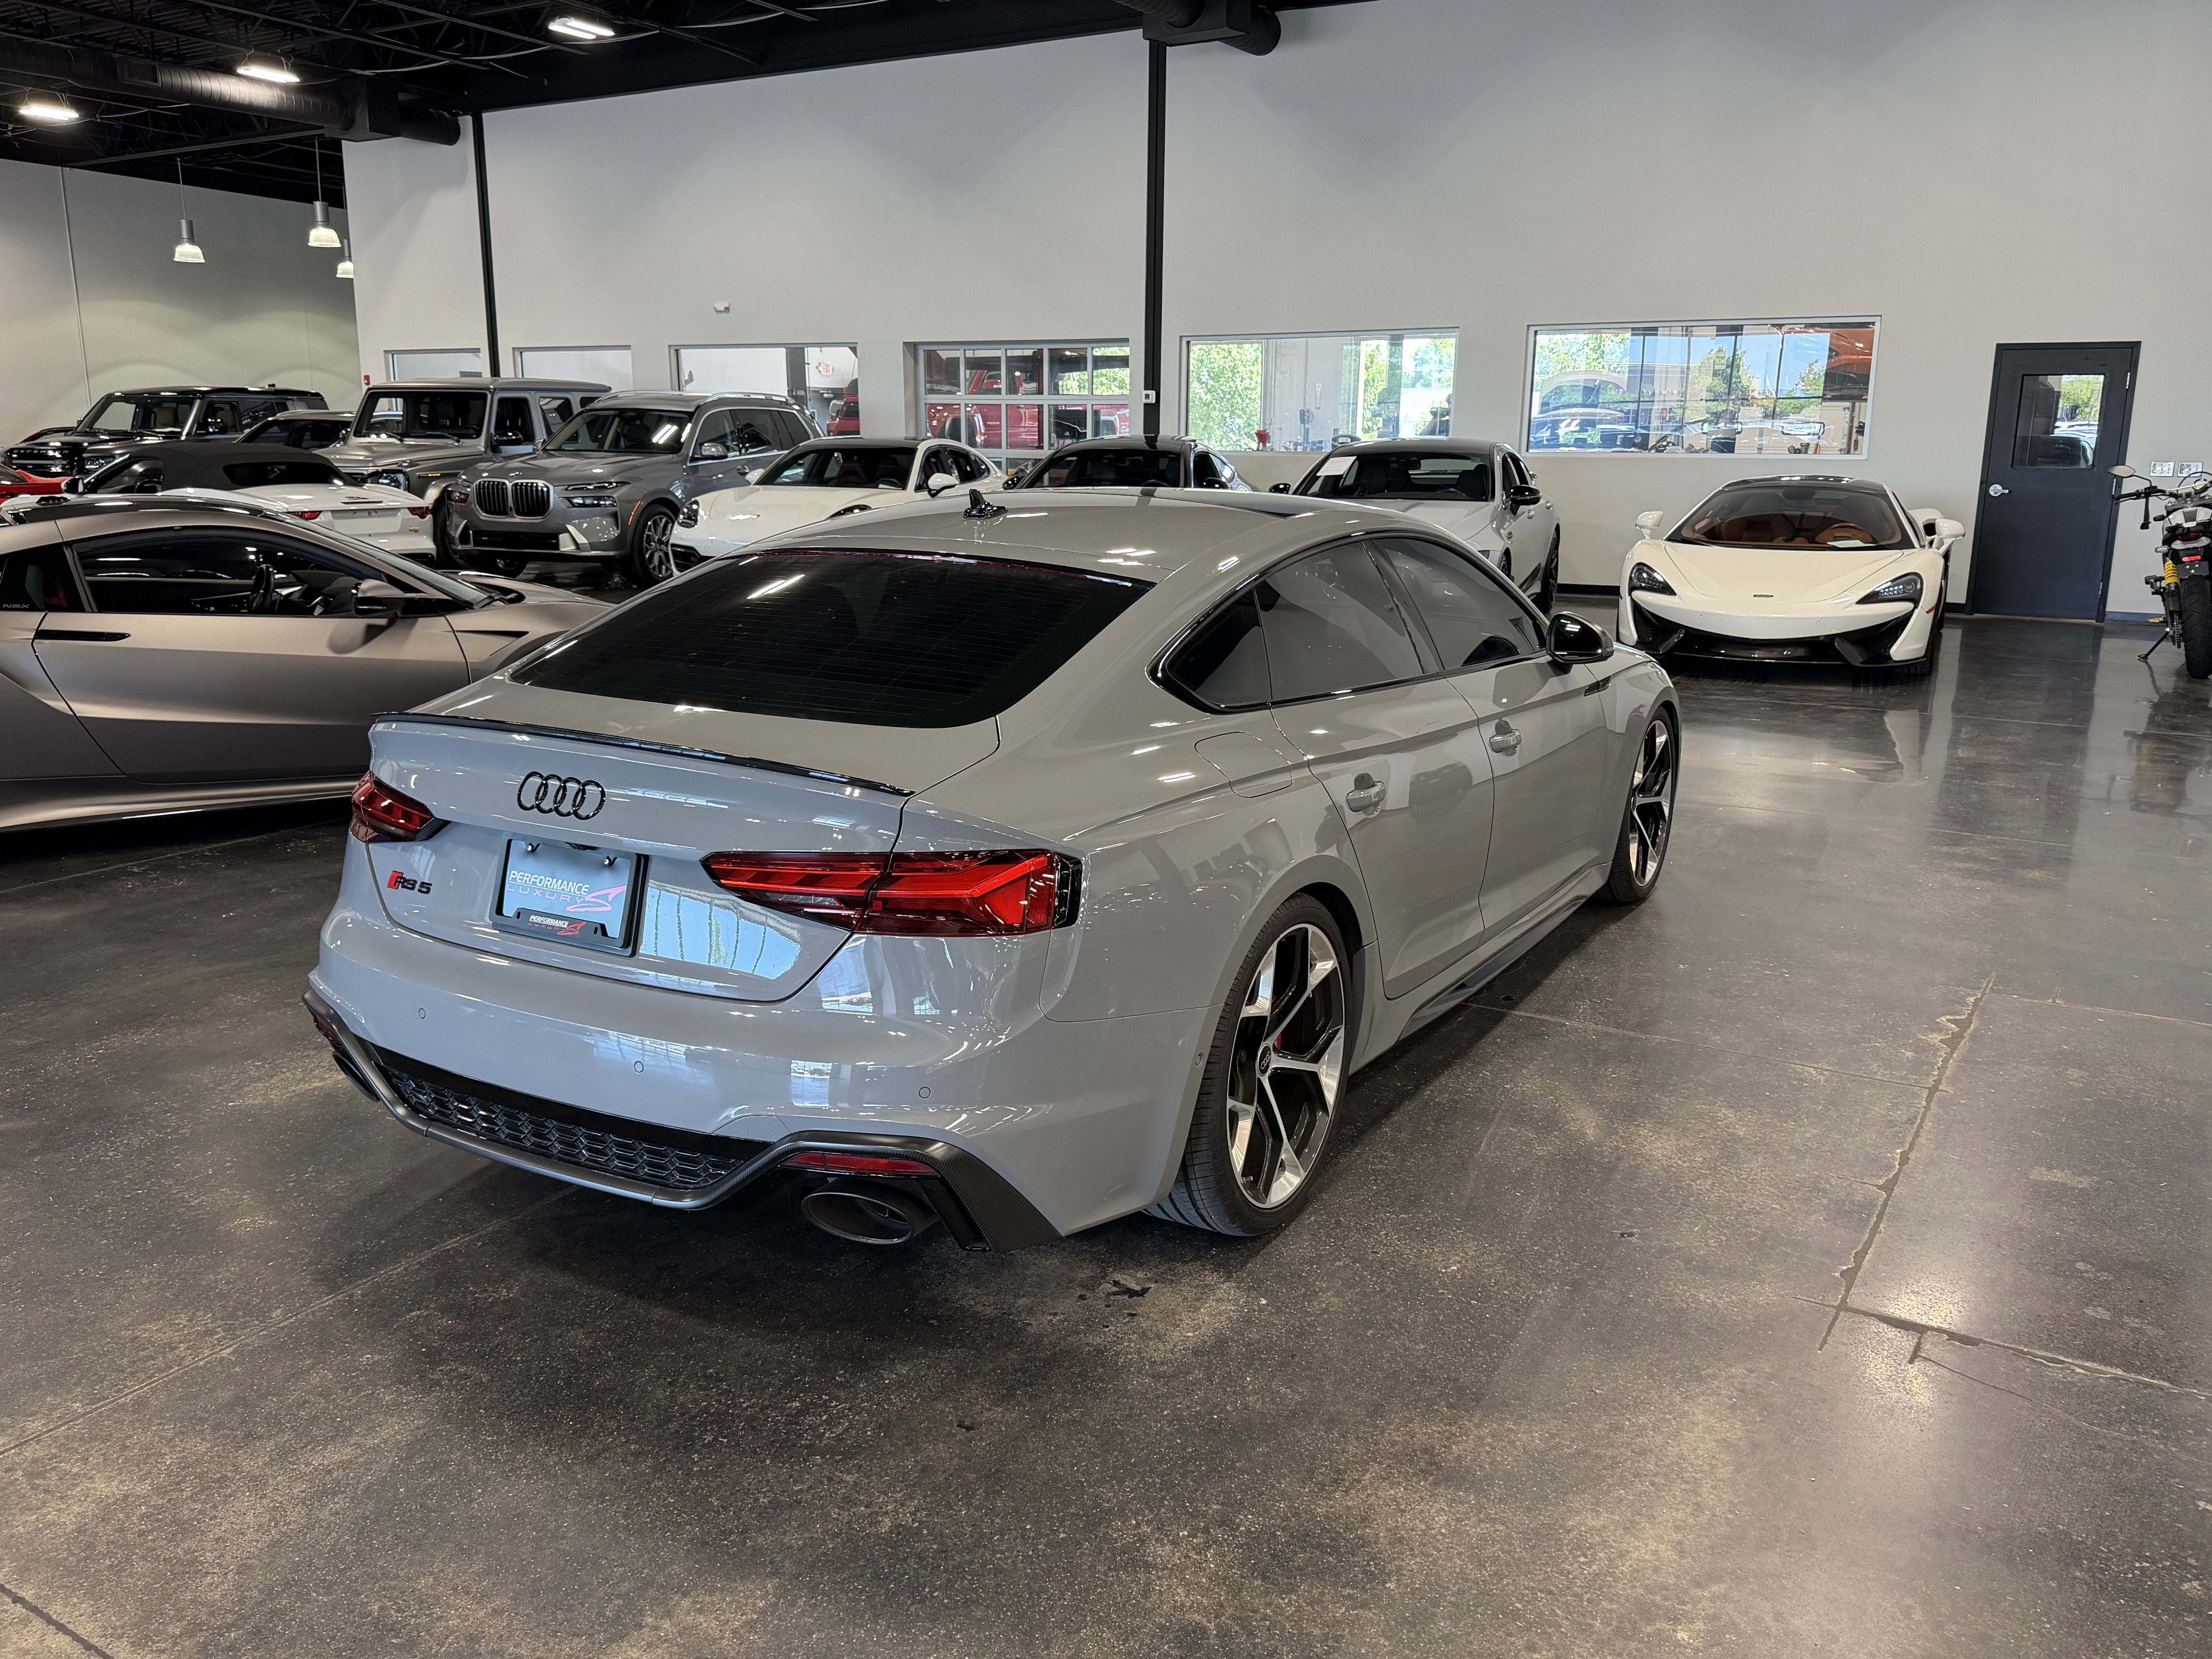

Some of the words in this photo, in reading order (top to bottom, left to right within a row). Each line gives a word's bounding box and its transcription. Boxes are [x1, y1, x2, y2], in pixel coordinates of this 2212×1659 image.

[507, 883, 584, 904] LUXURY
[509, 870, 589, 896] PERFORMANCE
[530, 915, 568, 927] PERFORMANCE
